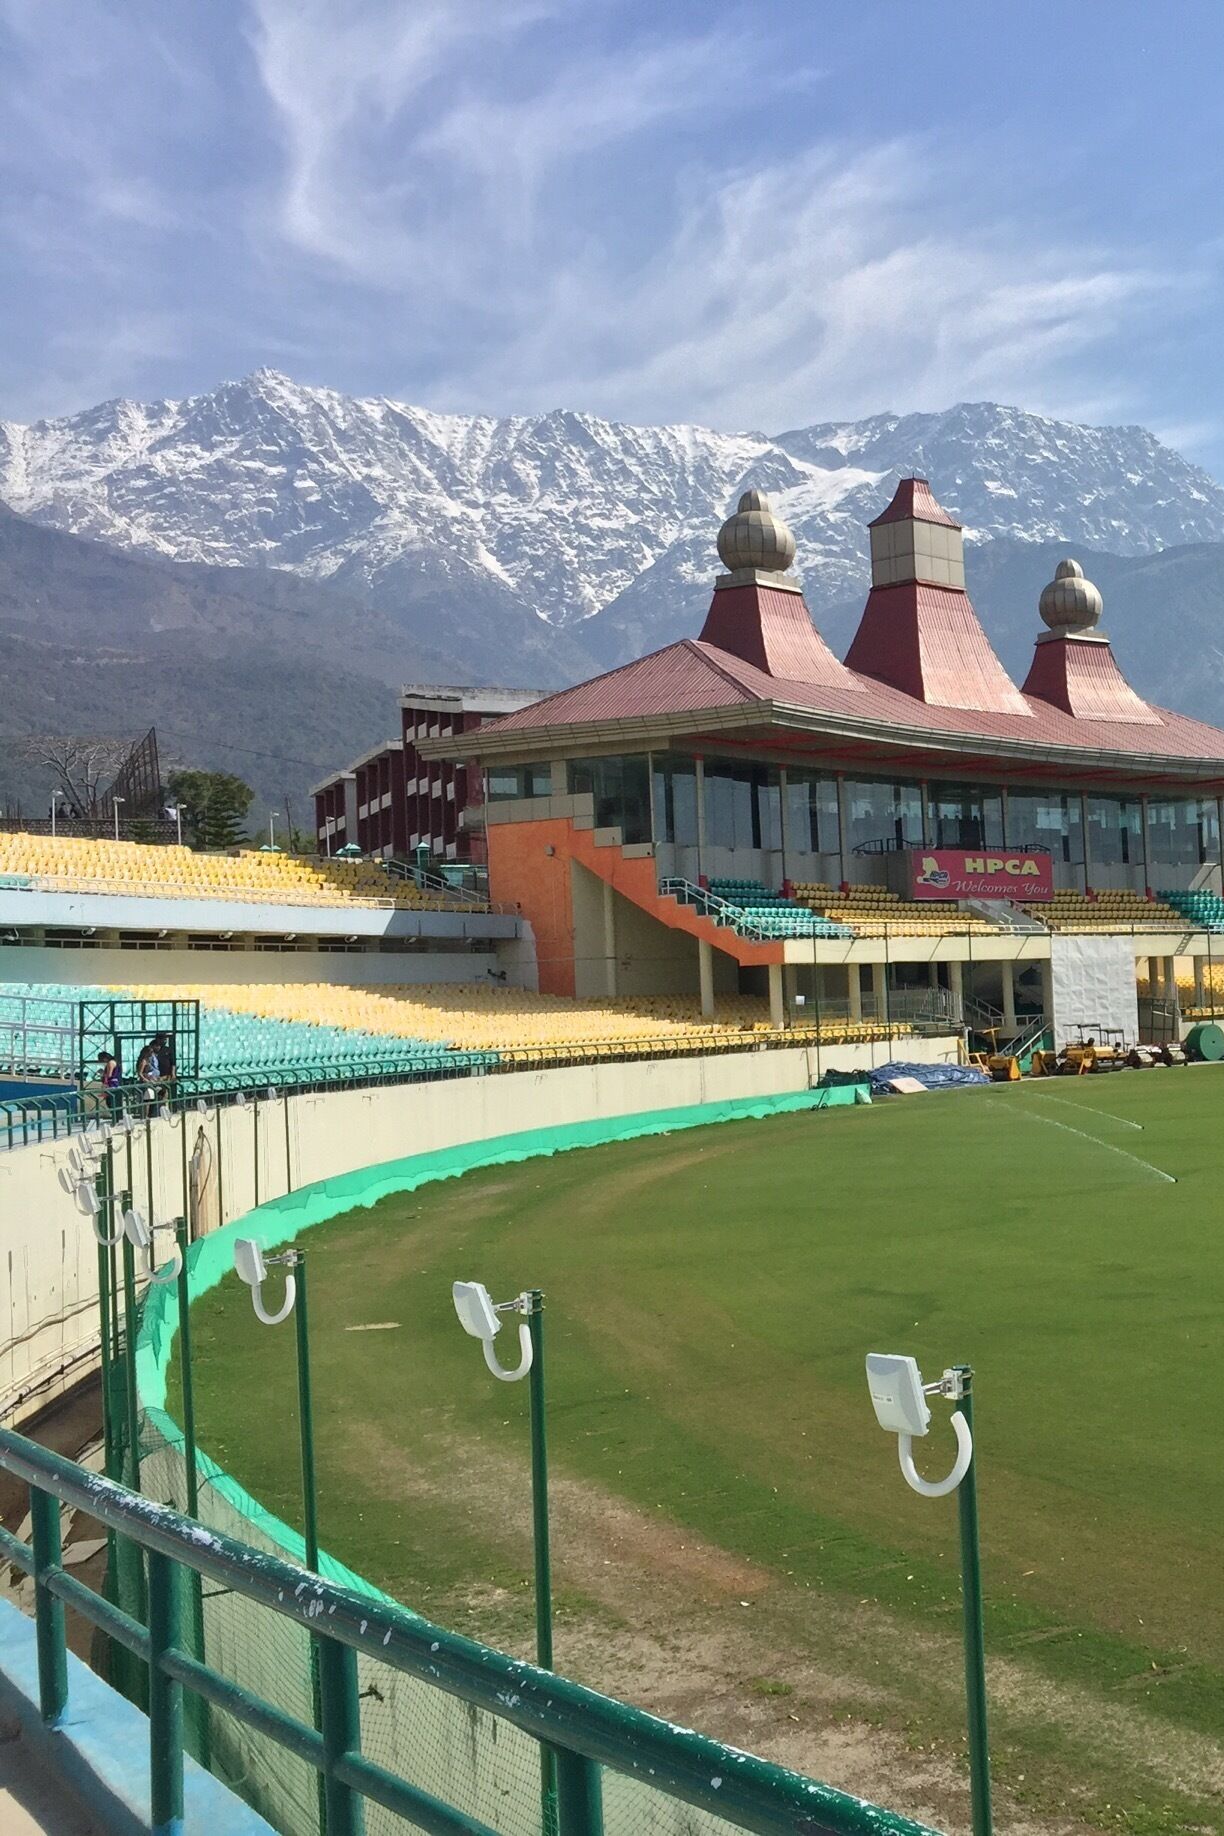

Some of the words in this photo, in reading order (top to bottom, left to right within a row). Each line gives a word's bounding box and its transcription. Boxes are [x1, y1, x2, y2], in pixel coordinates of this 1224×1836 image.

[964, 857, 1041, 876] HPCA
[952, 880, 1017, 893] Welcomes
[1022, 882, 1049, 895] You
